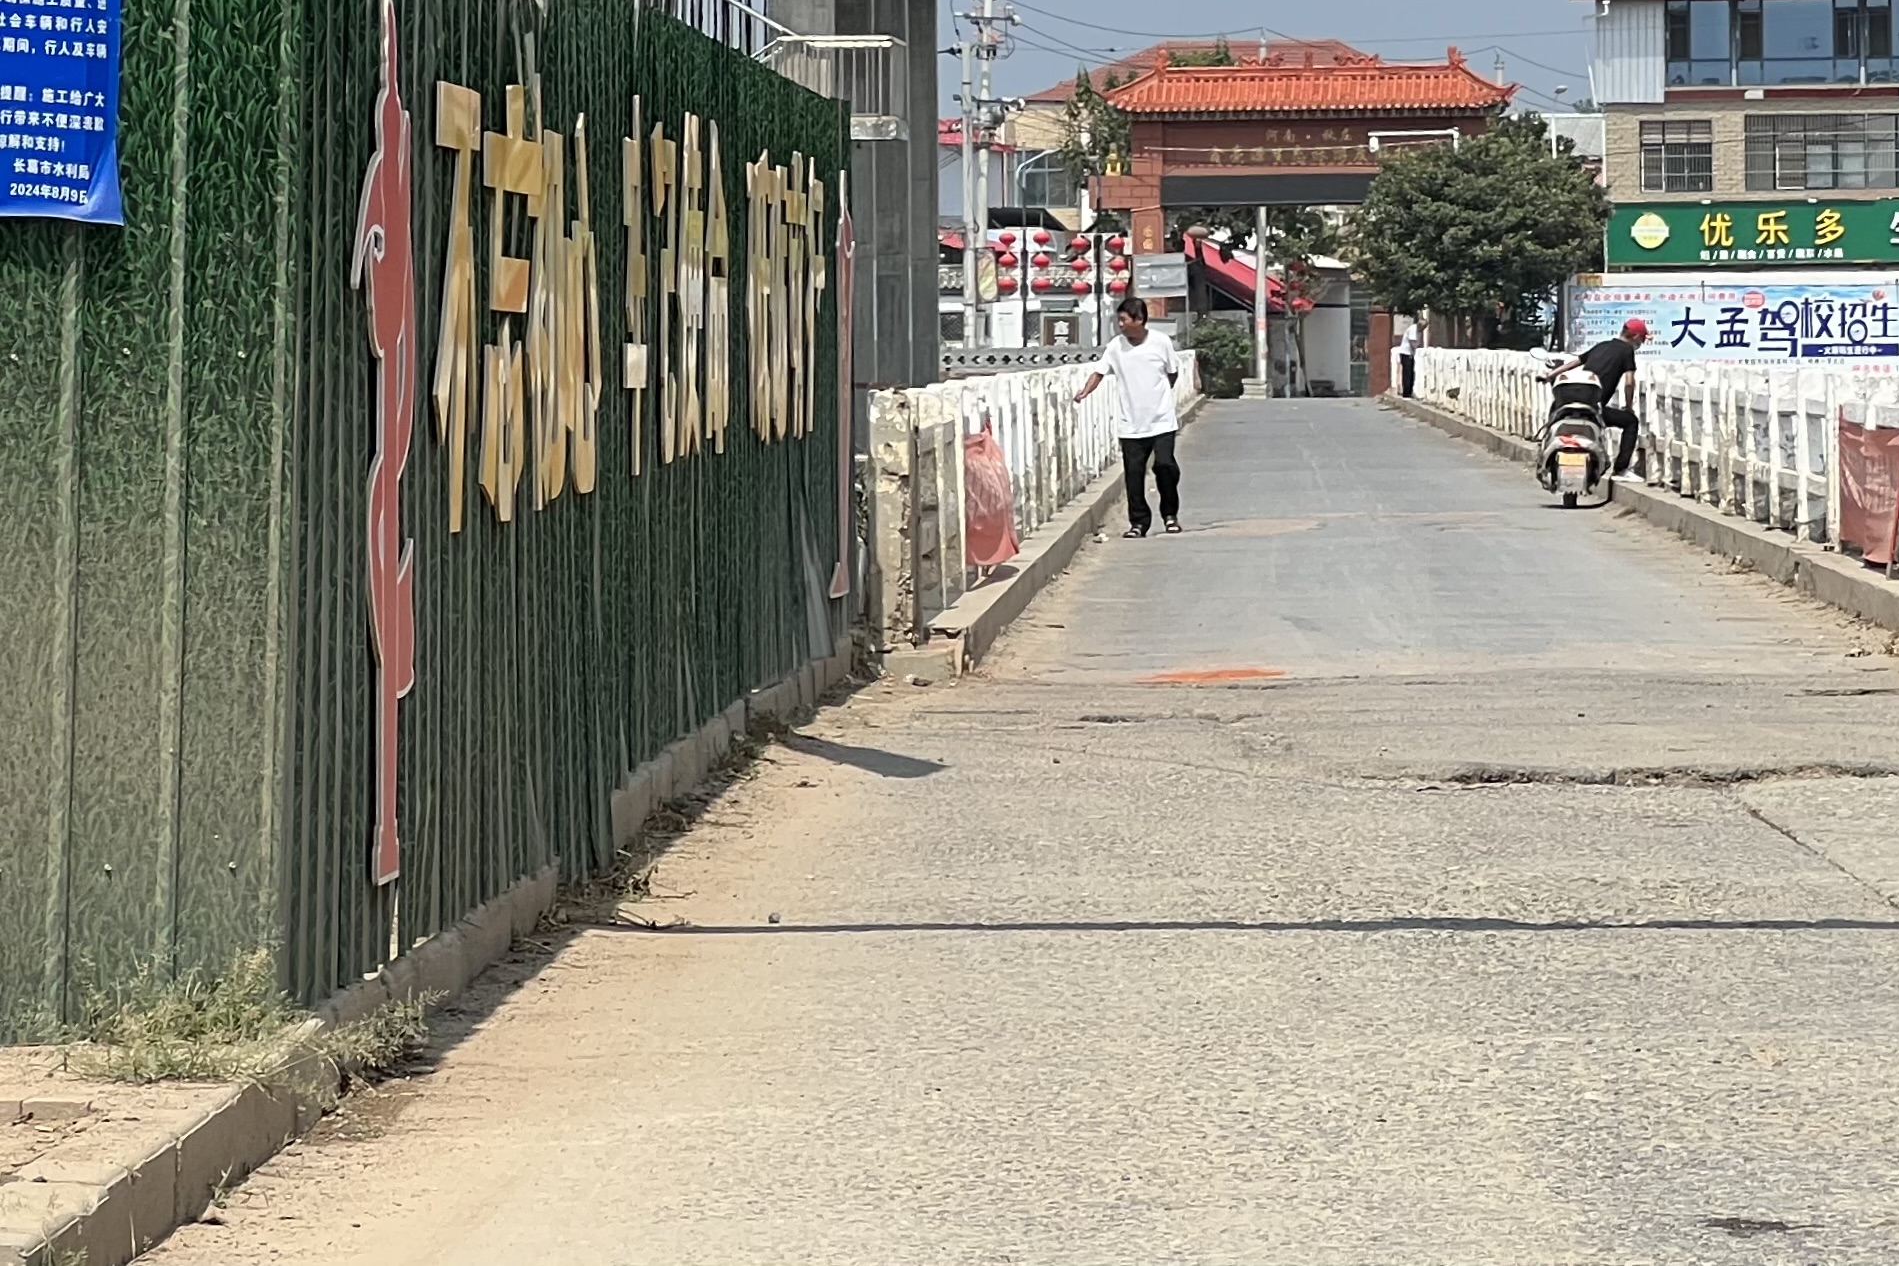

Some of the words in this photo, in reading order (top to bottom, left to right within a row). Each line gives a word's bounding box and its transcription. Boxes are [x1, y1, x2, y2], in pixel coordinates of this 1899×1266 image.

[0, 36, 107, 59] 期间，行人及车辆
[13, 158, 90, 180] 长葛市水利局
[9, 181, 89, 204] 2024年8月9日
[1699, 208, 1845, 246] 优乐多
[1670, 297, 1899, 358] 大孟驾校招生
